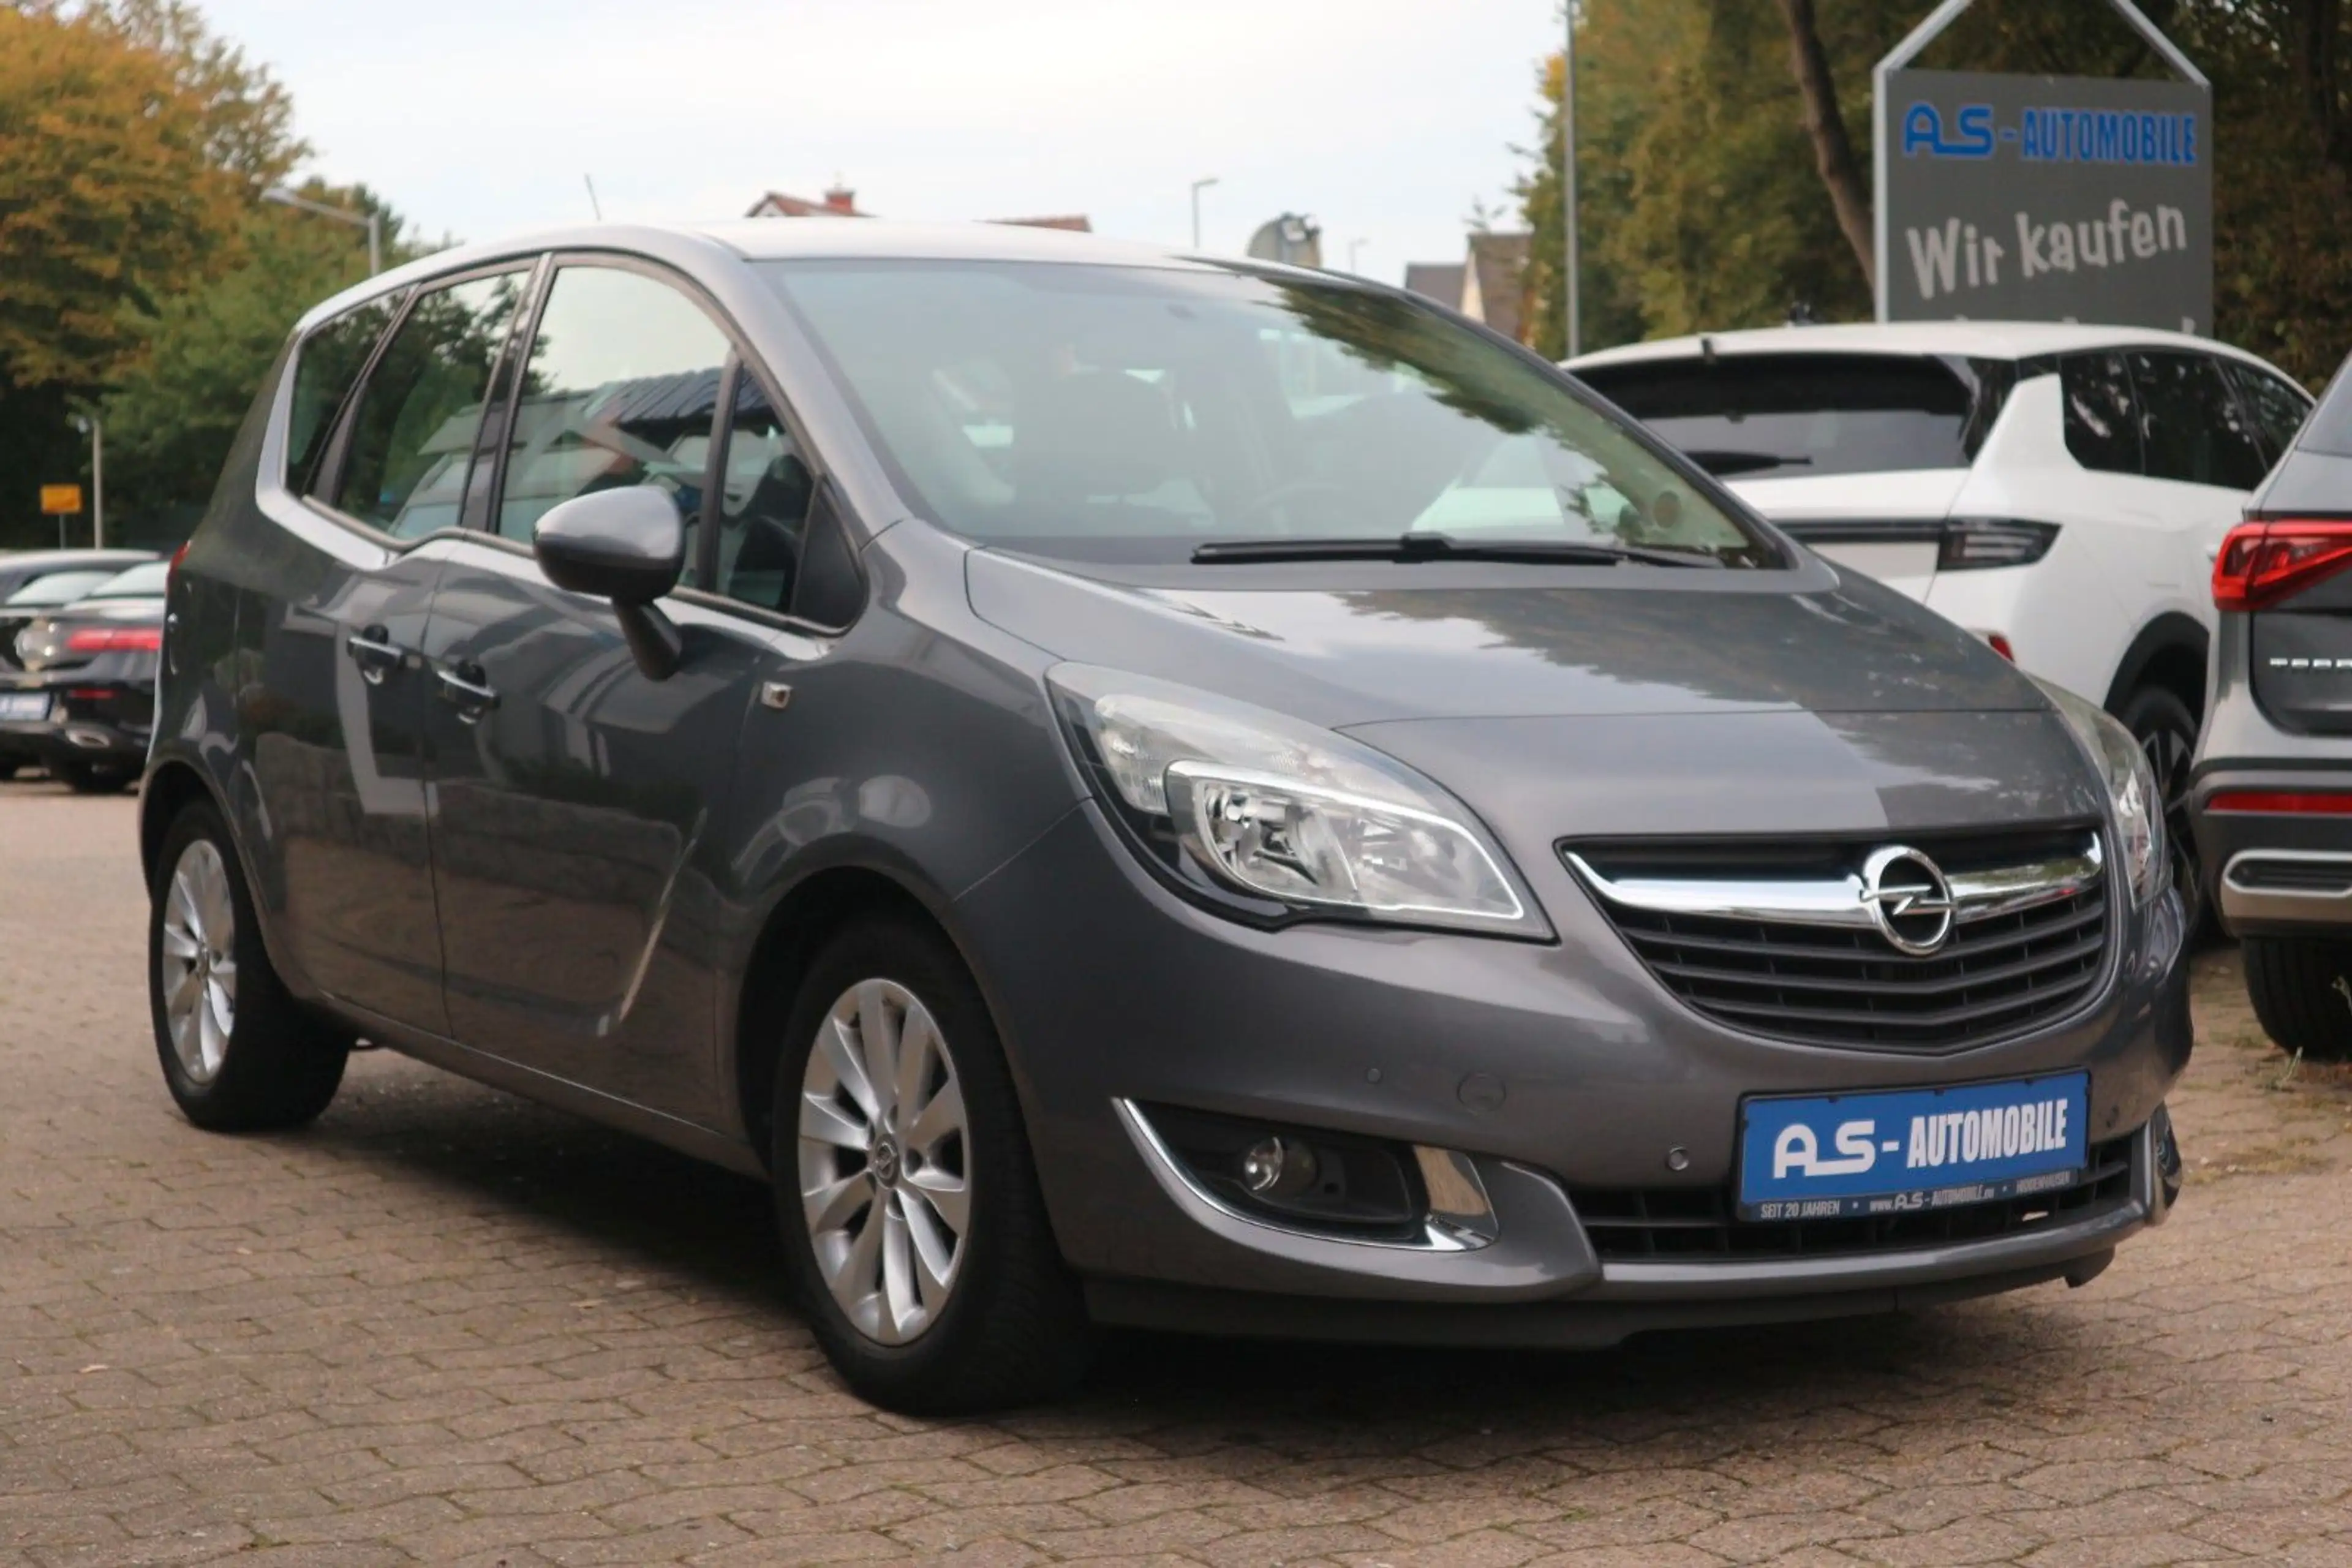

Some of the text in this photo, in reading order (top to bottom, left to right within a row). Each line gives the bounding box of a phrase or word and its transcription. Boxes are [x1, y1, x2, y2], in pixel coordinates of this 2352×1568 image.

[1902, 102, 2197, 166] AS-AUTOMOBILE
[1907, 198, 2187, 300] Wir kaufen
[1773, 1098, 2068, 1179] AS-AUTOMOBILE
[1760, 1202, 1783, 1218] SEIT
[1785, 1202, 1800, 1217] 20
[1801, 1200, 1841, 1216] JAHREN
